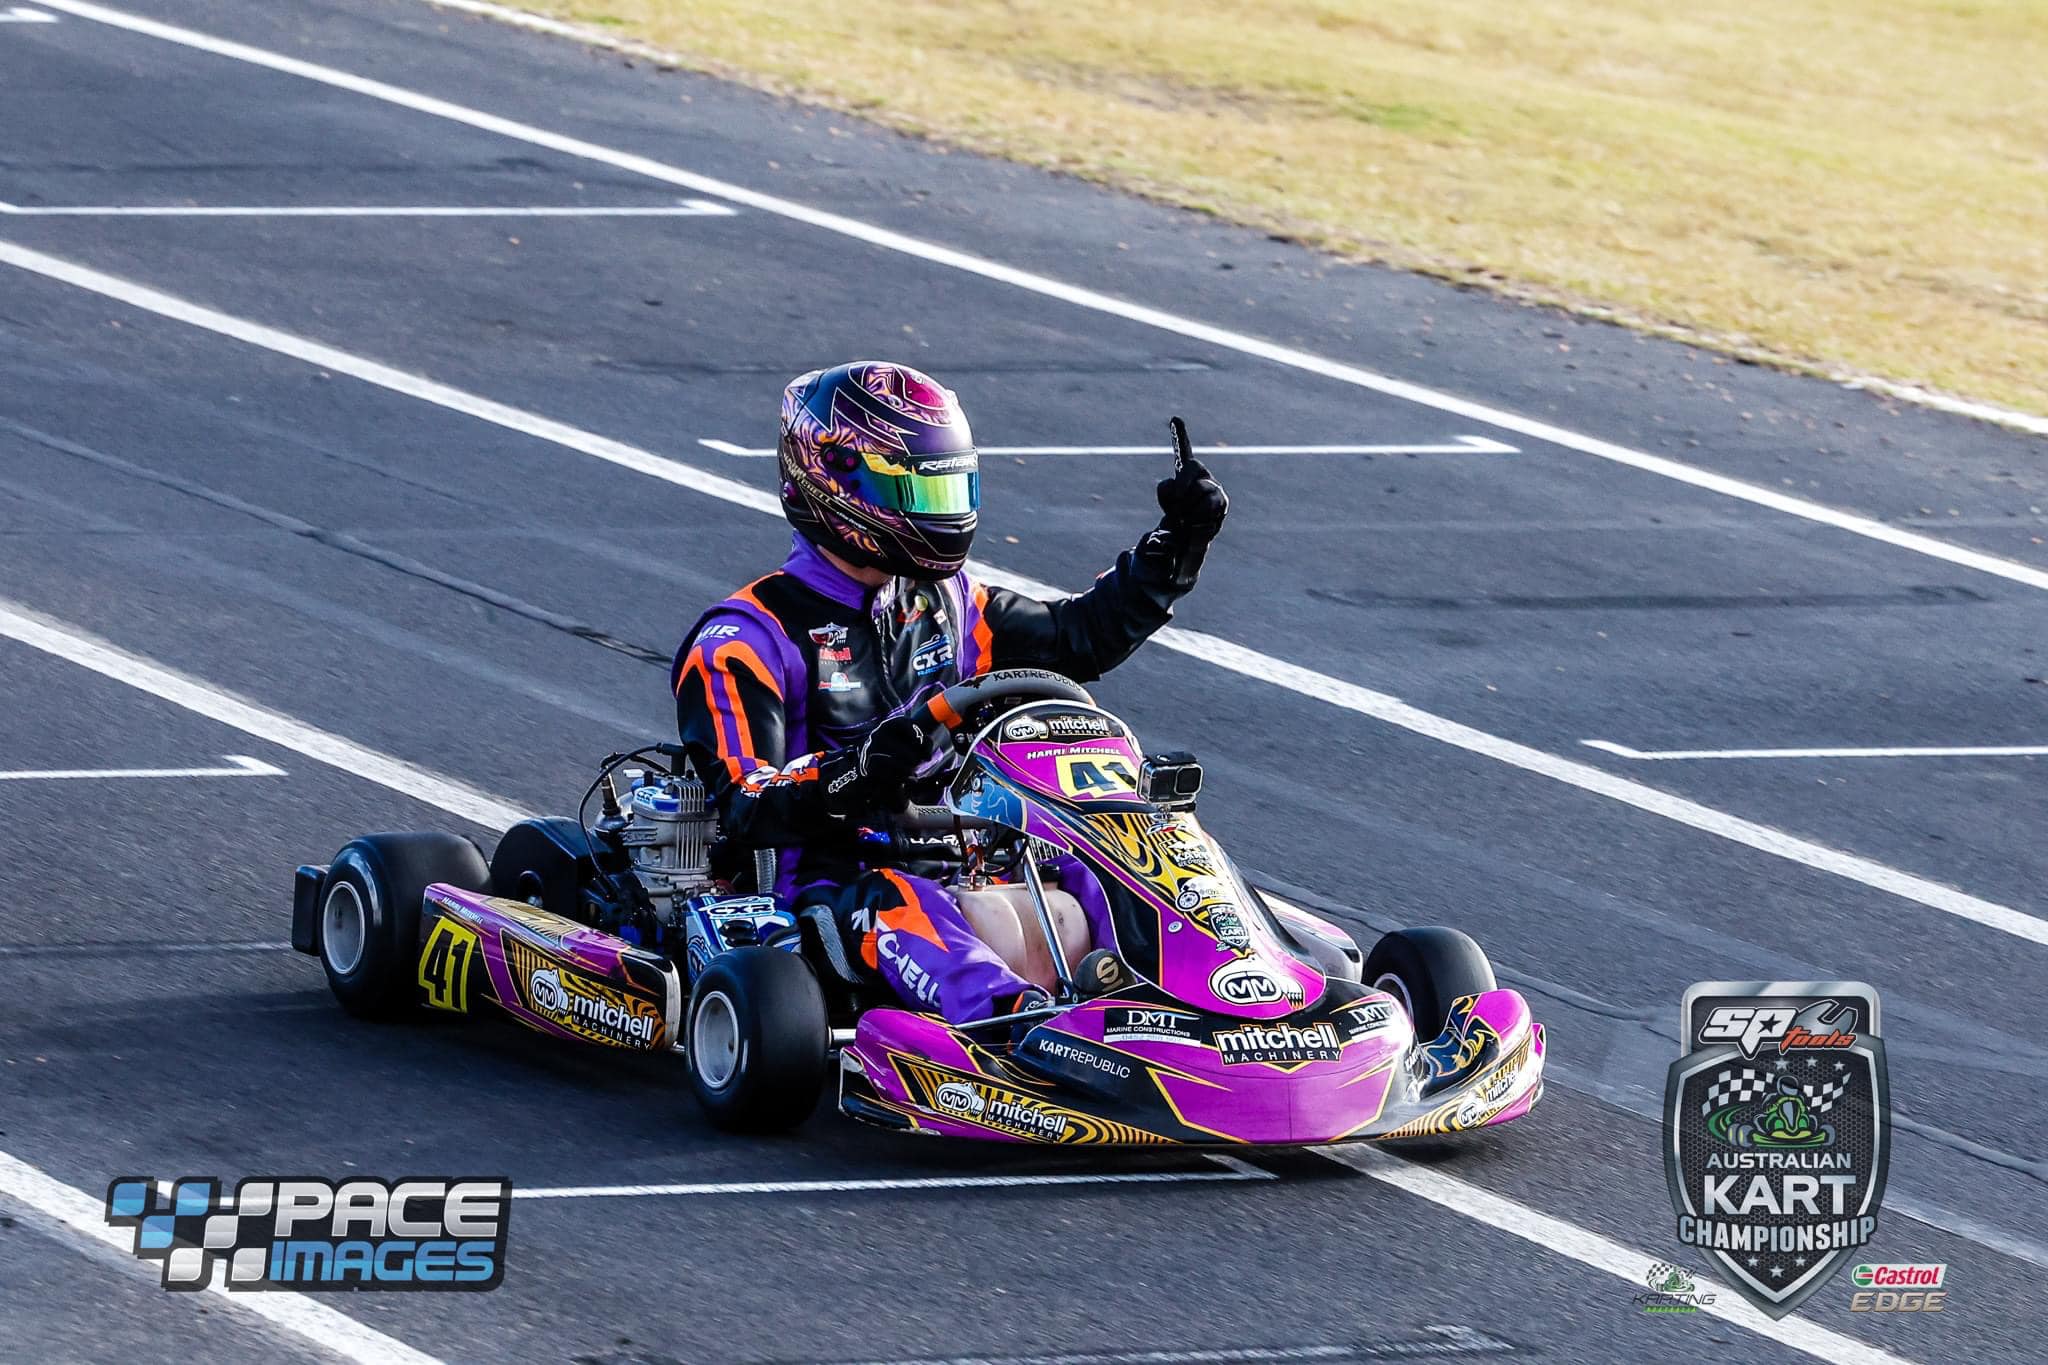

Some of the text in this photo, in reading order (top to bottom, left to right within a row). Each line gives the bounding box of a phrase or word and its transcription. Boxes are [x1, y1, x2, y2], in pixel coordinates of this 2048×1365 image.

[912, 645, 954, 671] CXR
[1049, 717, 1110, 731] mitchell
[1069, 746, 1121, 755] MITCHELL
[1069, 761, 1138, 792] 41
[708, 904, 773, 915] CXR
[422, 925, 473, 1010] 41
[573, 994, 655, 1041] mitchell
[1126, 1010, 1177, 1028] DMT
[572, 1014, 651, 1051] MACHINERY
[1216, 1024, 1339, 1052] mitchell
[1038, 1039, 1131, 1079] KARTREPUBLIC
[1223, 1050, 1341, 1064] MACHINERY
[987, 1114, 1062, 1141] MACHINERY
[989, 1099, 1068, 1134] mitchell
